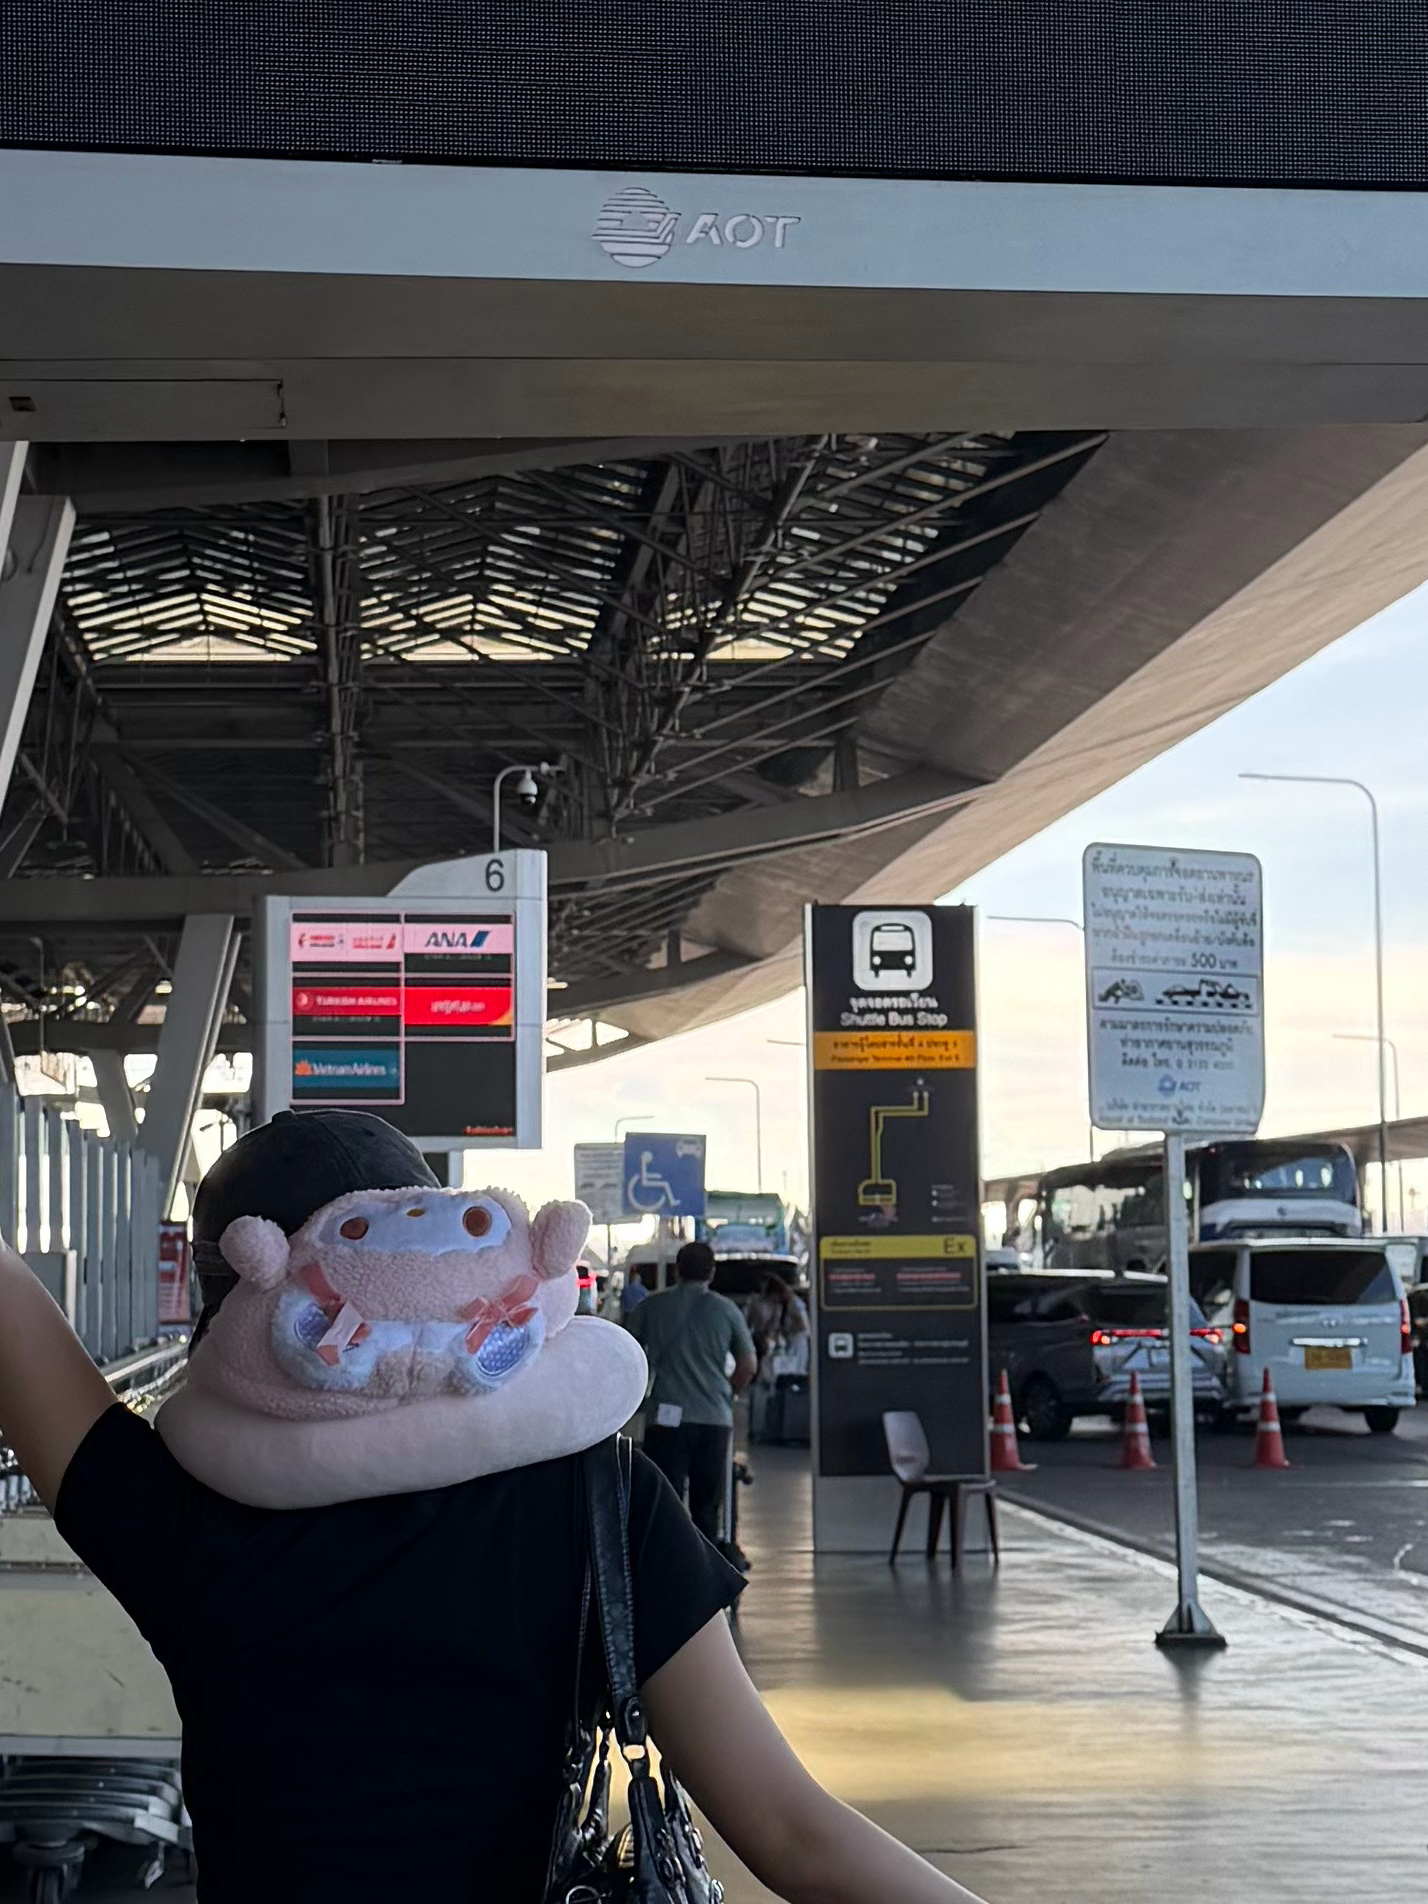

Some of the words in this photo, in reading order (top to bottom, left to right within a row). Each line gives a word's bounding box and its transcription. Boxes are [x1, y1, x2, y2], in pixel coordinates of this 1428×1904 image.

[686, 213, 801, 248] AOT
[486, 859, 504, 892] 6
[425, 932, 468, 947] ANA
[1191, 953, 1216, 968] 500
[888, 1011, 914, 1026] Bus
[943, 1238, 965, 1254] Ex
